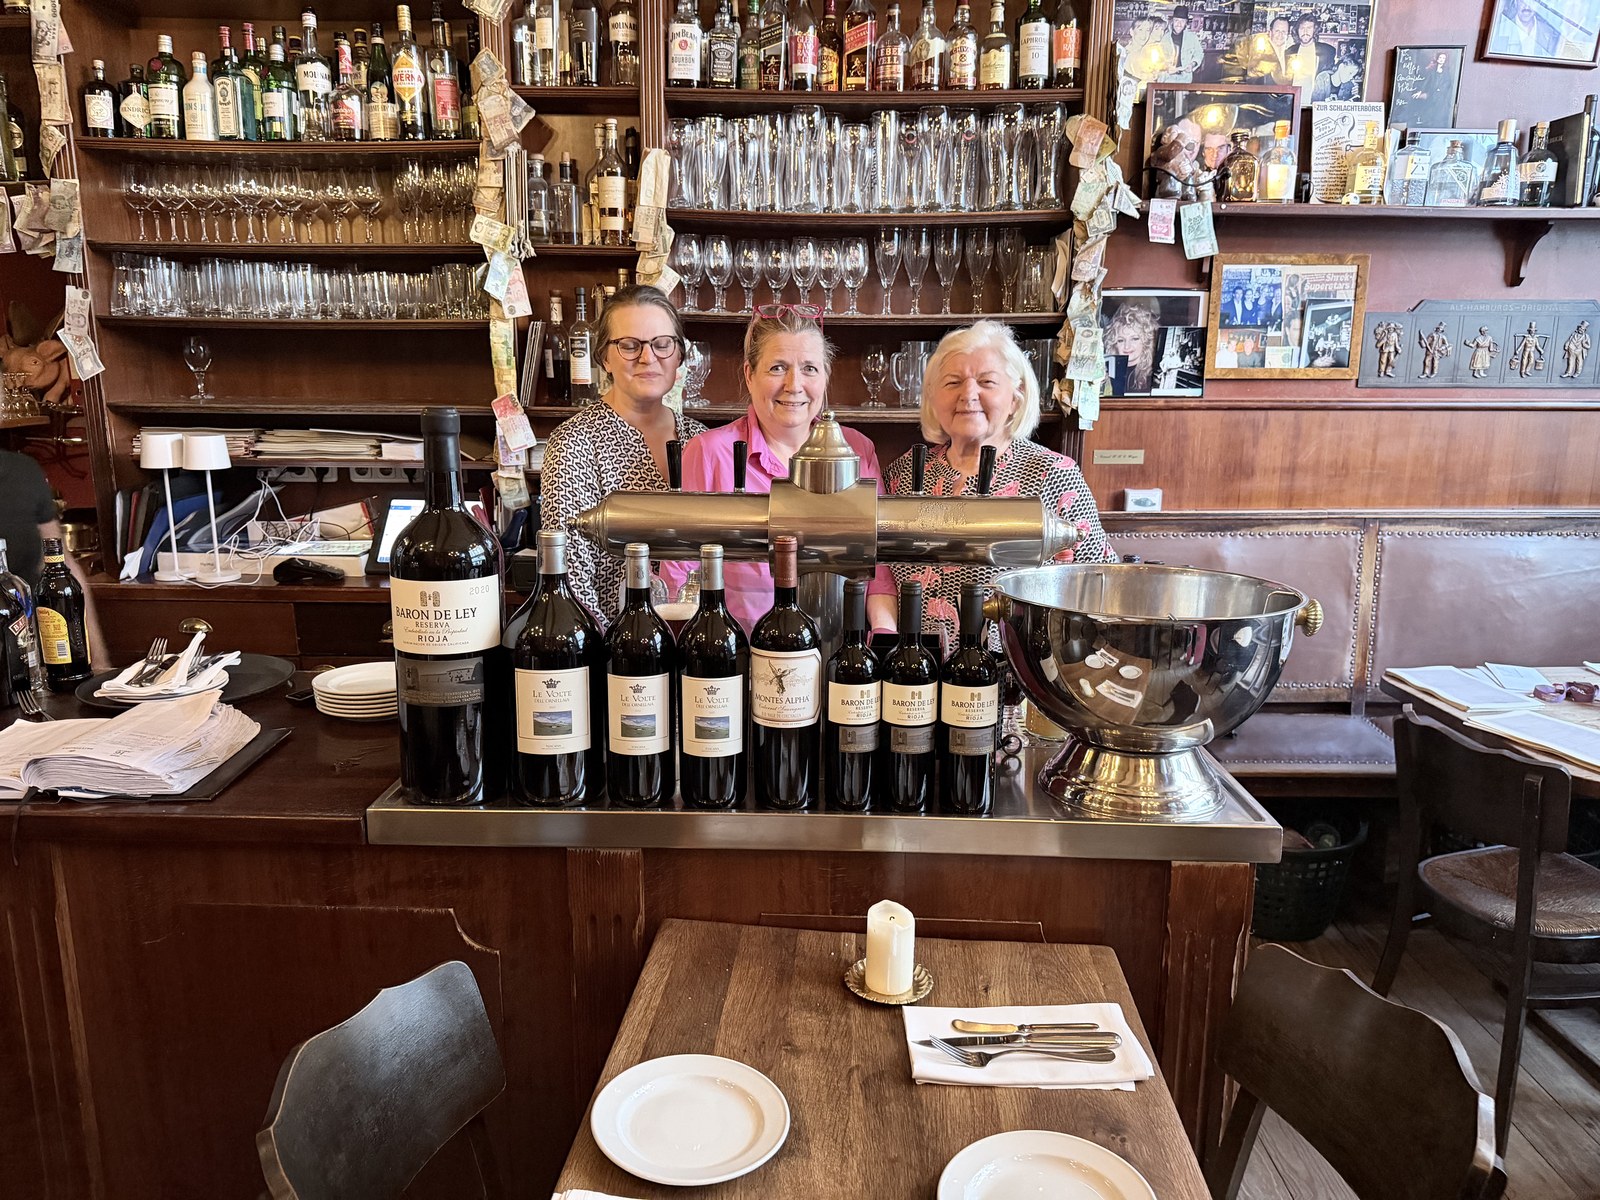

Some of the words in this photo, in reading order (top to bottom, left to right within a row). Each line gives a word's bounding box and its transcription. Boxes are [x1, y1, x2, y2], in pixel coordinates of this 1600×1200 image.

[670, 31, 681, 43] JIM
[469, 584, 490, 595] 2020
[396, 606, 429, 620] BARON
[434, 610, 451, 620] DE
[456, 607, 477, 619] LEY
[755, 693, 783, 704] MONTES
[785, 696, 810, 704] ALPHA
[892, 699, 915, 707] BARON
[951, 700, 975, 708] BARON
